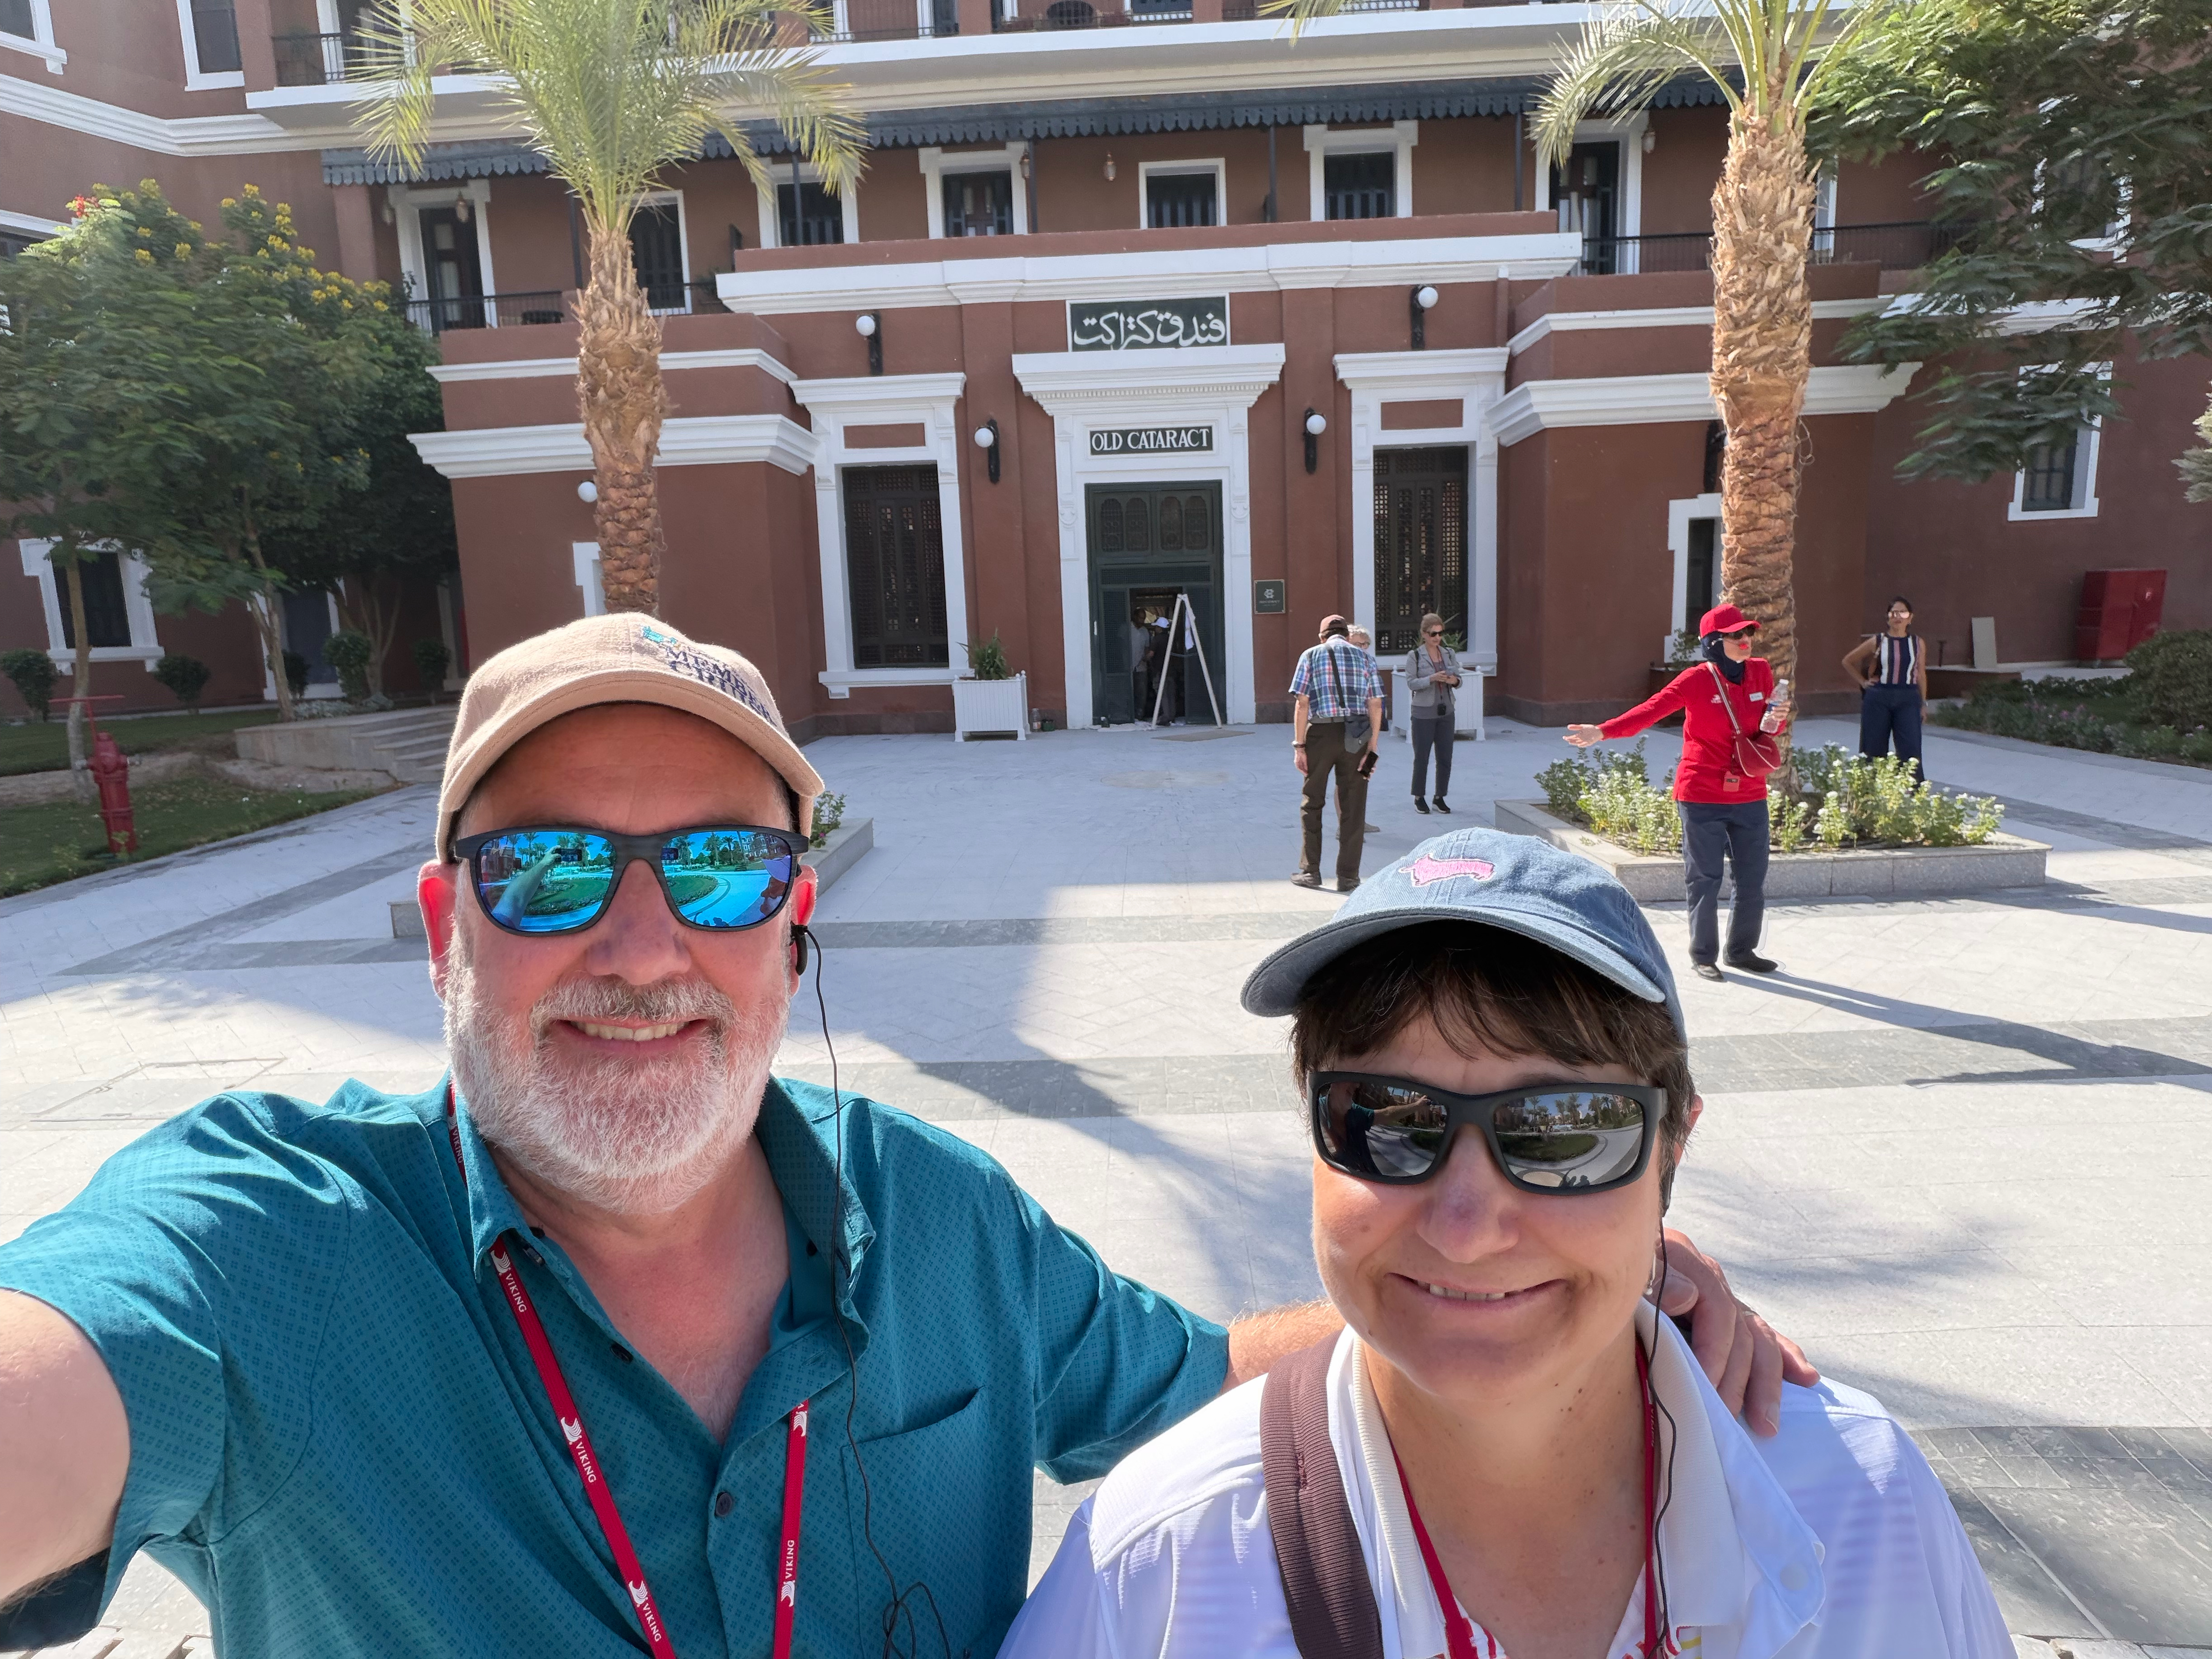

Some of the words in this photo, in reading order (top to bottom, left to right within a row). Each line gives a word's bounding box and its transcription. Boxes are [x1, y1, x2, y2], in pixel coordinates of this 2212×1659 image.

[1156, 311, 1226, 347] فندق
[1092, 432, 1123, 451] OLD
[1127, 428, 1209, 449] CATARACT
[453, 1129, 464, 1163] VIKING
[506, 1273, 527, 1313] VIKING
[576, 1441, 597, 1483] VIKING
[785, 1540, 795, 1579] VIKING
[643, 1603, 662, 1642] VIKING
